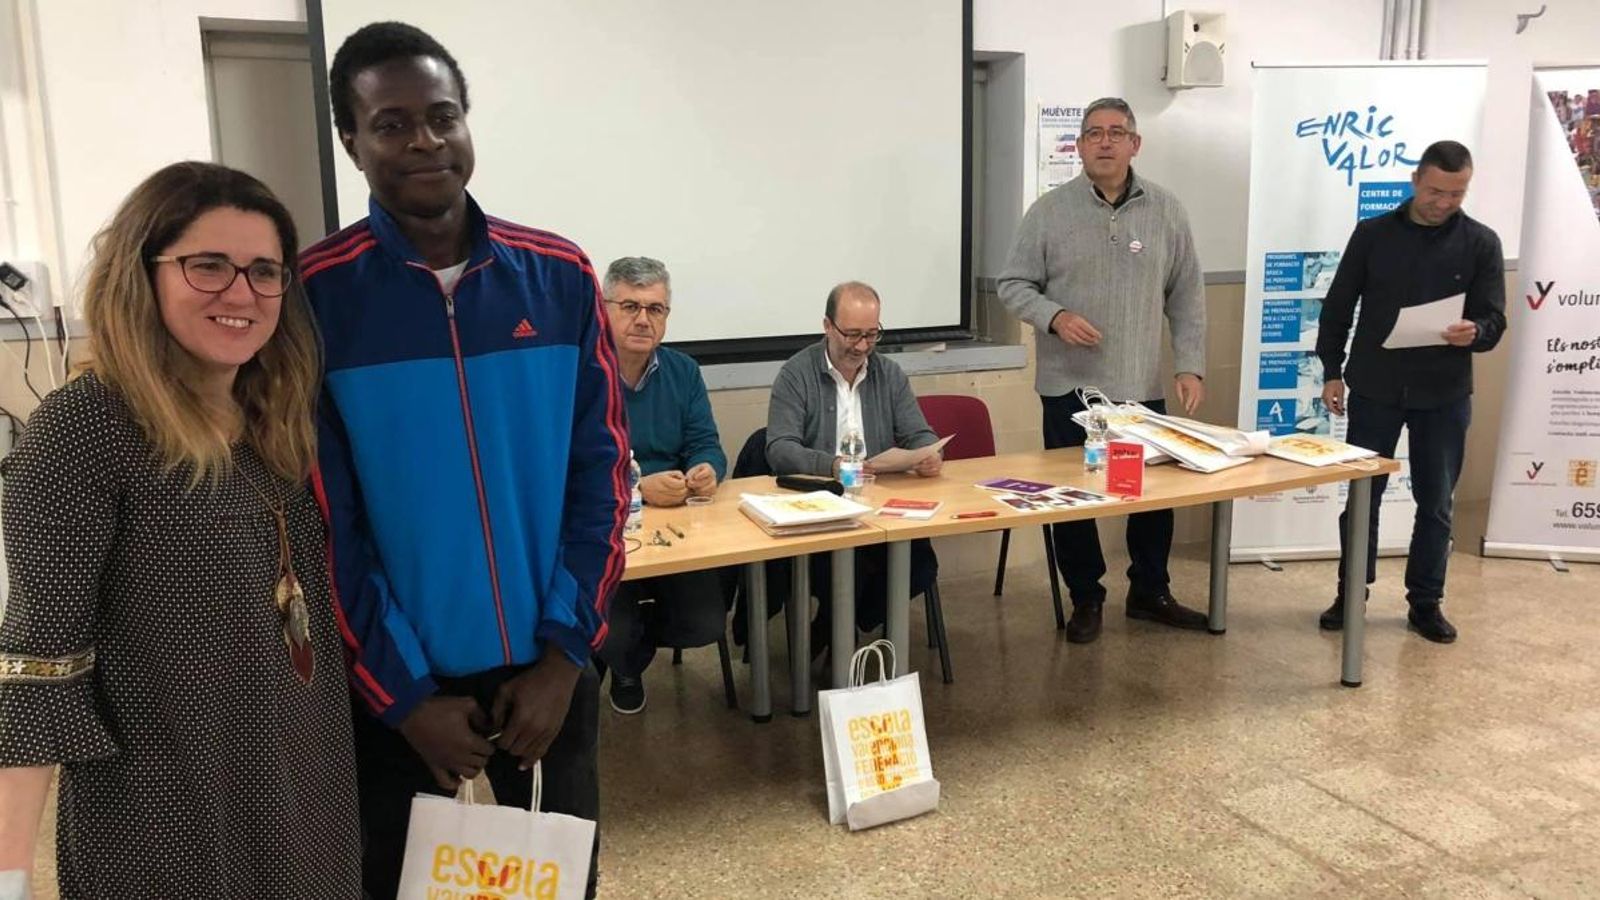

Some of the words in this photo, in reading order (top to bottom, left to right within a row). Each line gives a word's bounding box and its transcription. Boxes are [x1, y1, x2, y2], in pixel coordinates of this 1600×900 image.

[1041, 106, 1082, 116] MUÉVETE
[1361, 189, 1390, 198] CENTRE
[1391, 189, 1403, 198] DE
[1547, 338, 1569, 352] Els
[848, 710, 911, 741] escola
[430, 843, 561, 900] escola
